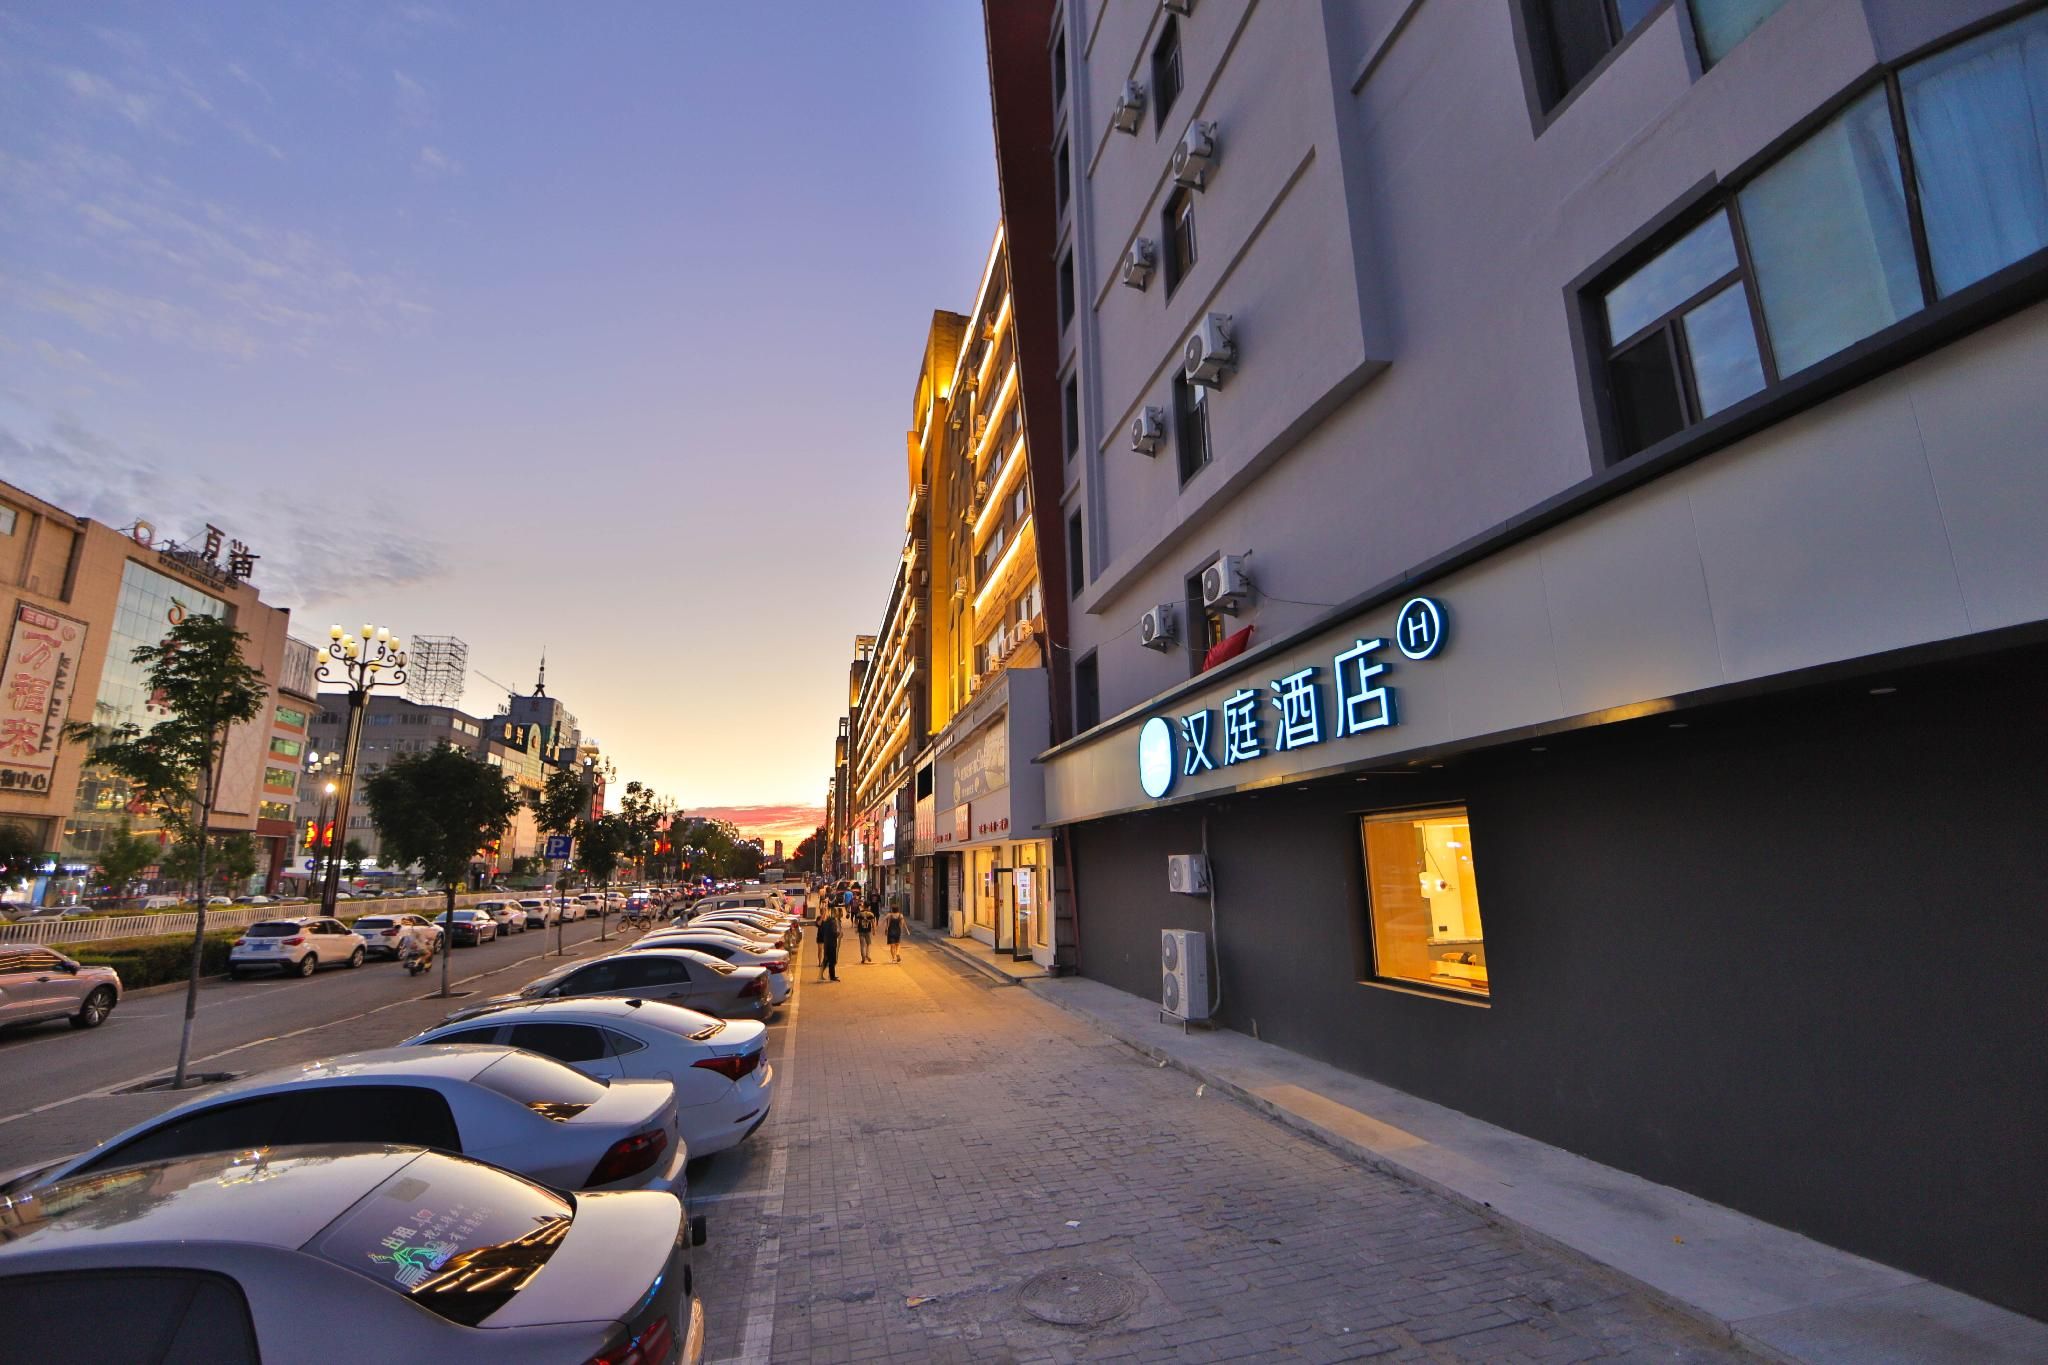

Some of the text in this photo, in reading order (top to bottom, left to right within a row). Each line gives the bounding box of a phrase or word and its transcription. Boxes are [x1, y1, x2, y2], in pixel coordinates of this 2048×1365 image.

[1181, 637, 1397, 776] 汉庭酒店
[548, 838, 566, 856] P
